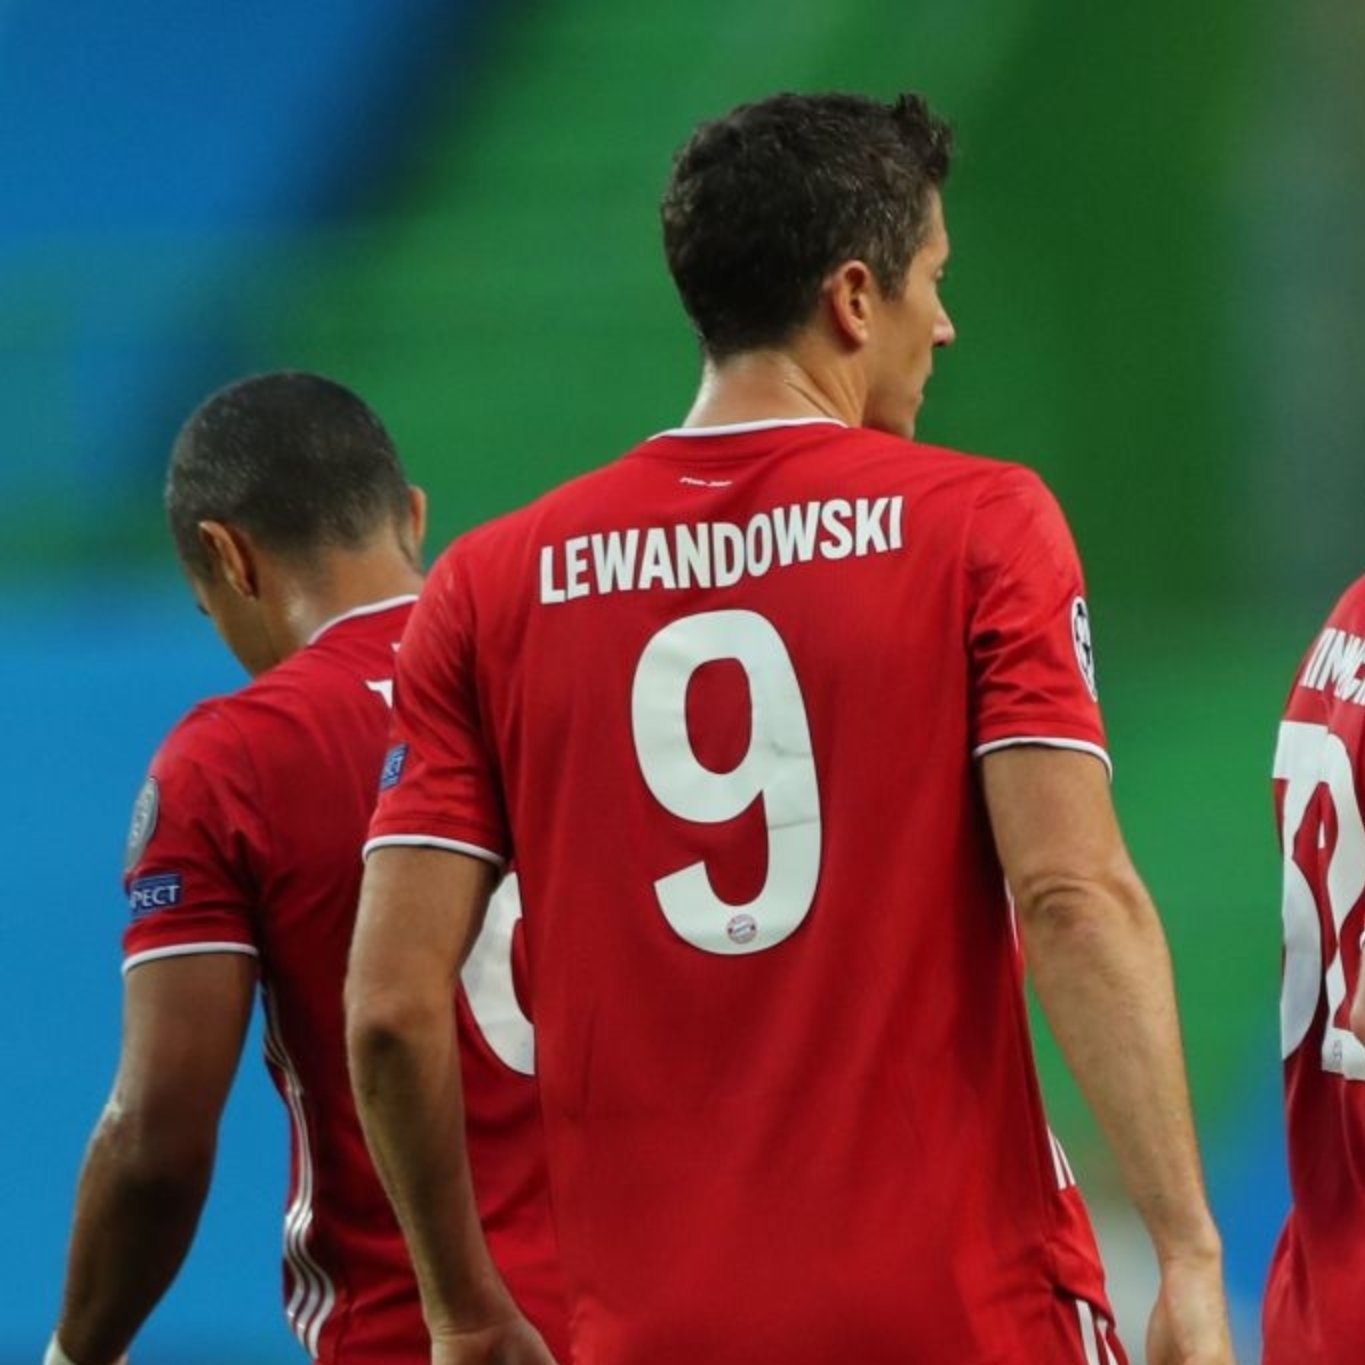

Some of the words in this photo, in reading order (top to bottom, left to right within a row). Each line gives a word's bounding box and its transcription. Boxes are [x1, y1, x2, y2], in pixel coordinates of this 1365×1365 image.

[540, 495, 903, 604] LEWANDOWSKI
[631, 609, 821, 955] 9
[128, 885, 181, 909] PECT
